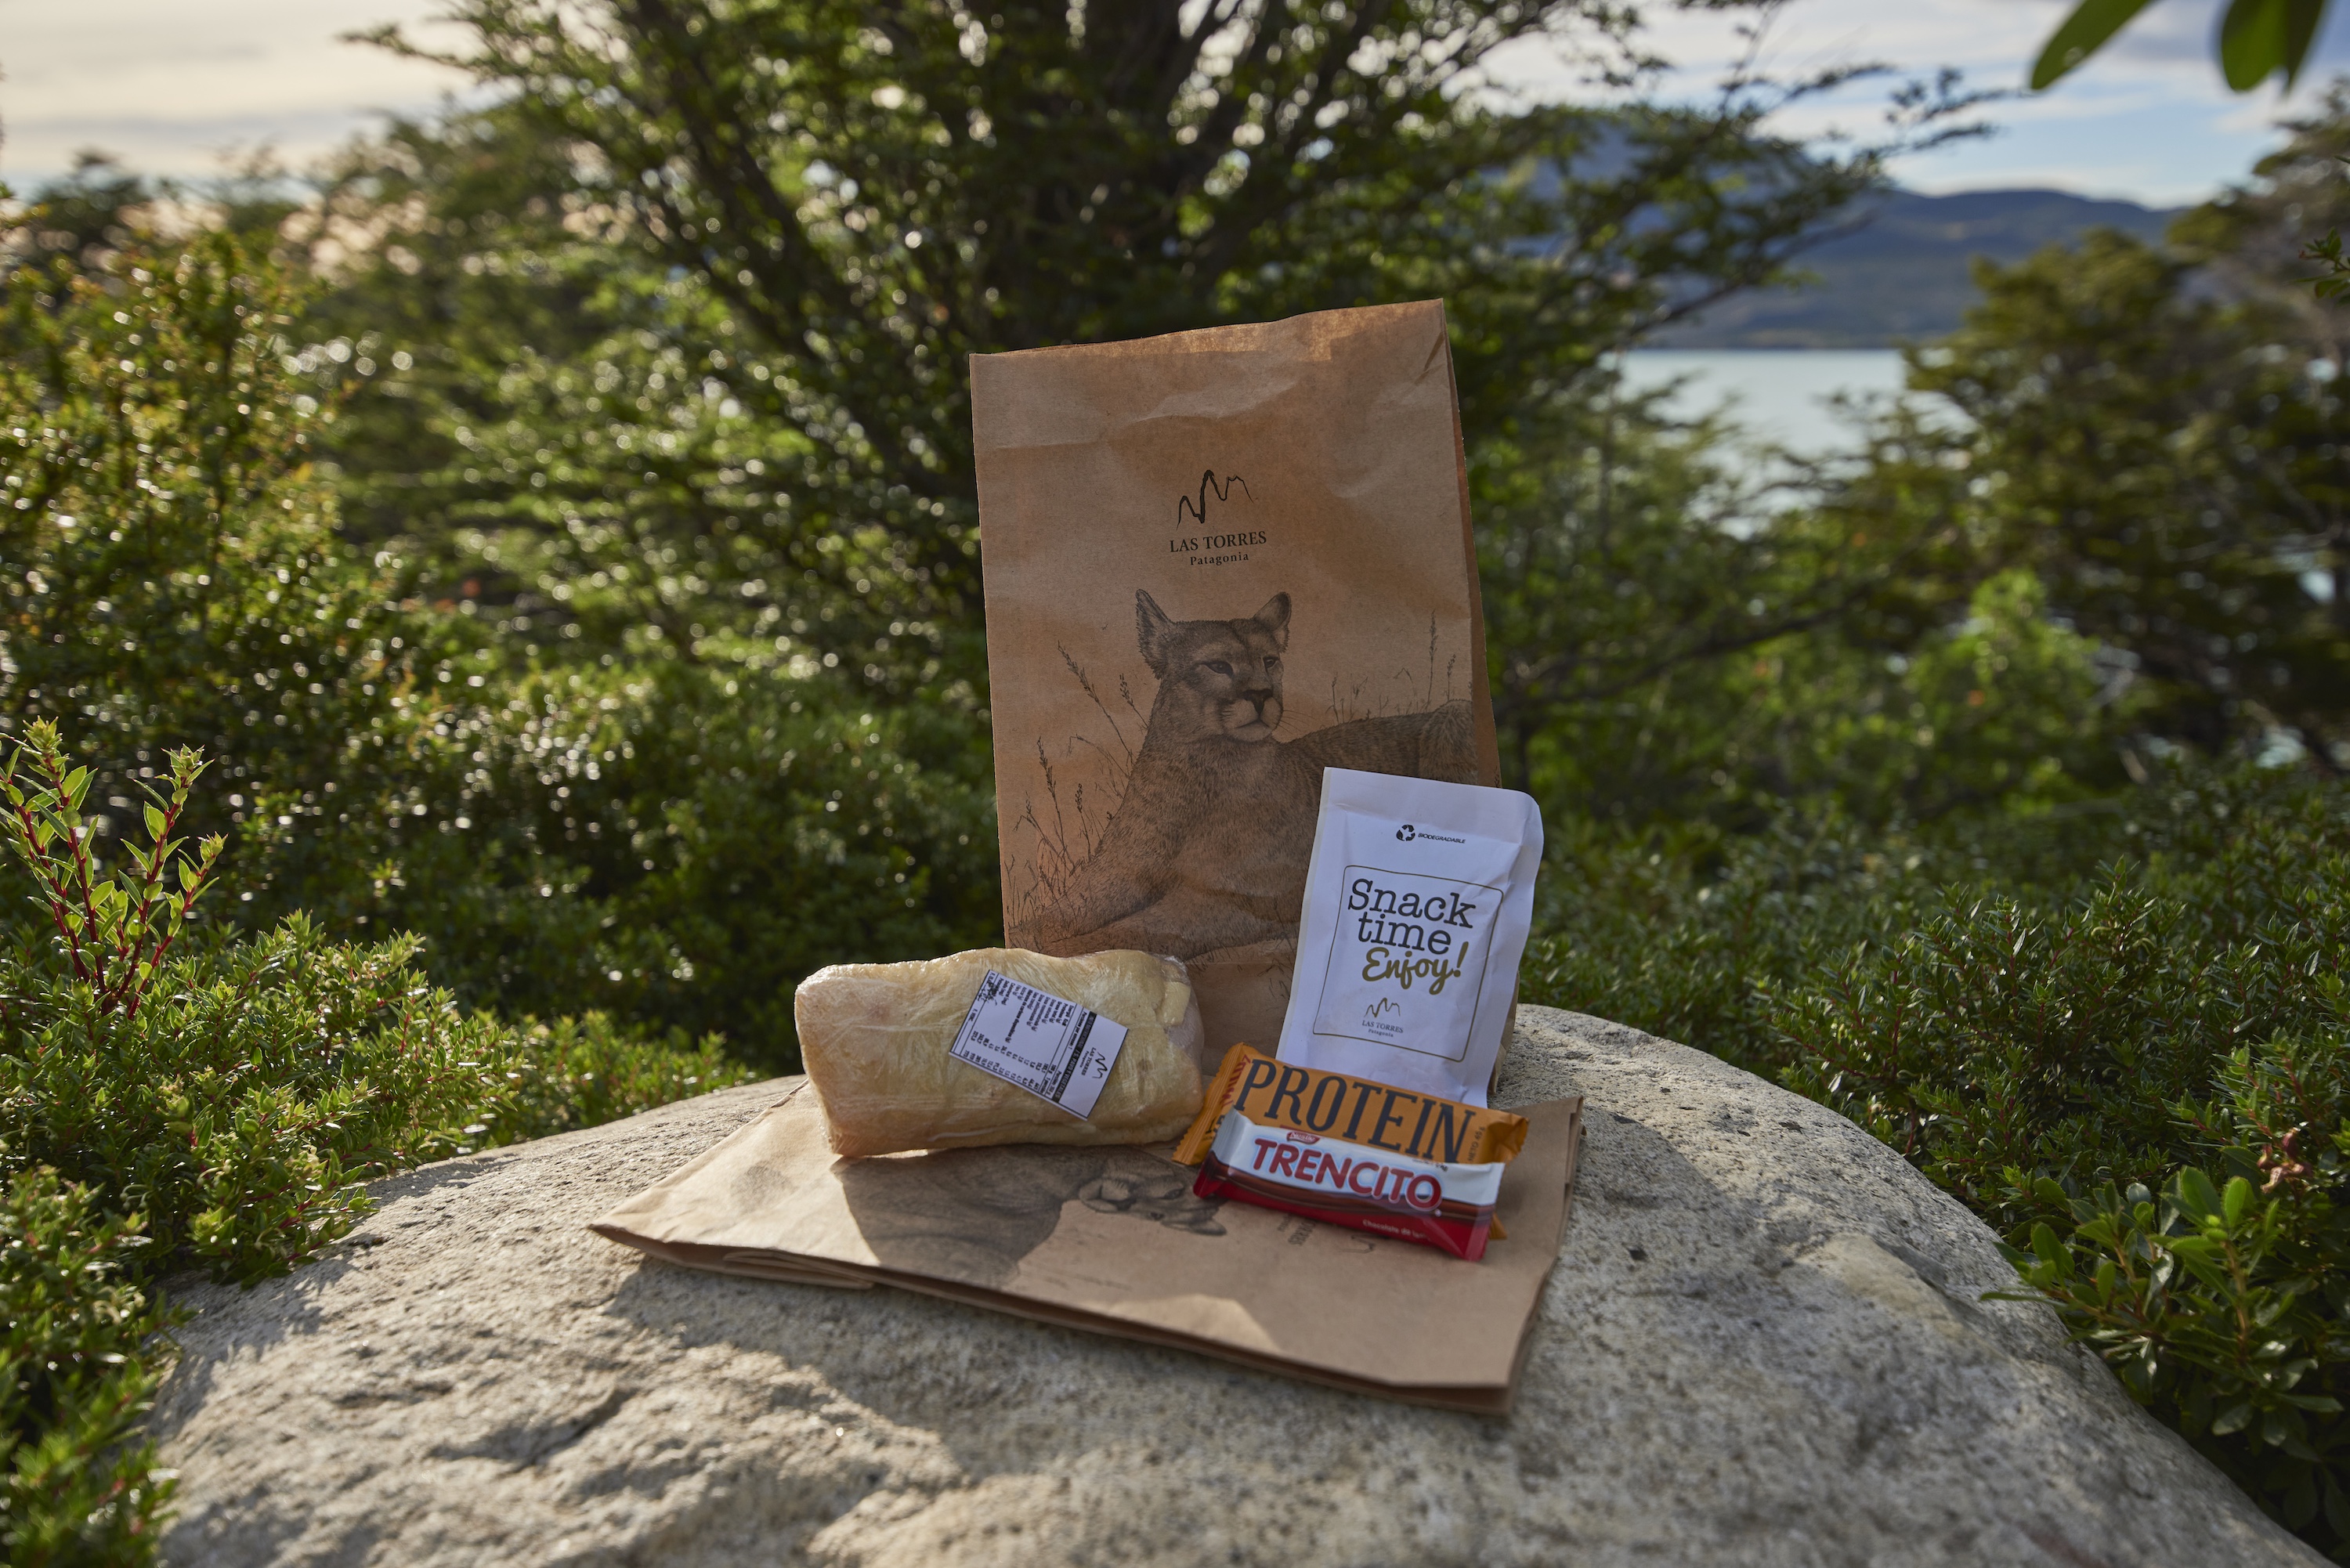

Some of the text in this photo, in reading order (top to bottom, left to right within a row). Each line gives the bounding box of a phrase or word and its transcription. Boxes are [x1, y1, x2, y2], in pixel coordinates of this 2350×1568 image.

[1170, 530, 1267, 553] LAS TORRES
[1190, 551, 1249, 565] Patagonia
[1418, 833, 1466, 844] BIODEGRADABLE
[1347, 878, 1477, 929] Snack
[1358, 912, 1452, 955] time
[1362, 941, 1469, 995] Enjoy!
[1368, 1028, 1394, 1037] Patagonia
[1376, 1022, 1404, 1033] TORRES
[1080, 1057, 1093, 1075] TORRES
[1235, 1059, 1477, 1164] PROTEIN
[1253, 1138, 1443, 1209] TRENCITO
[1362, 1219, 1399, 1234] Chocolate
